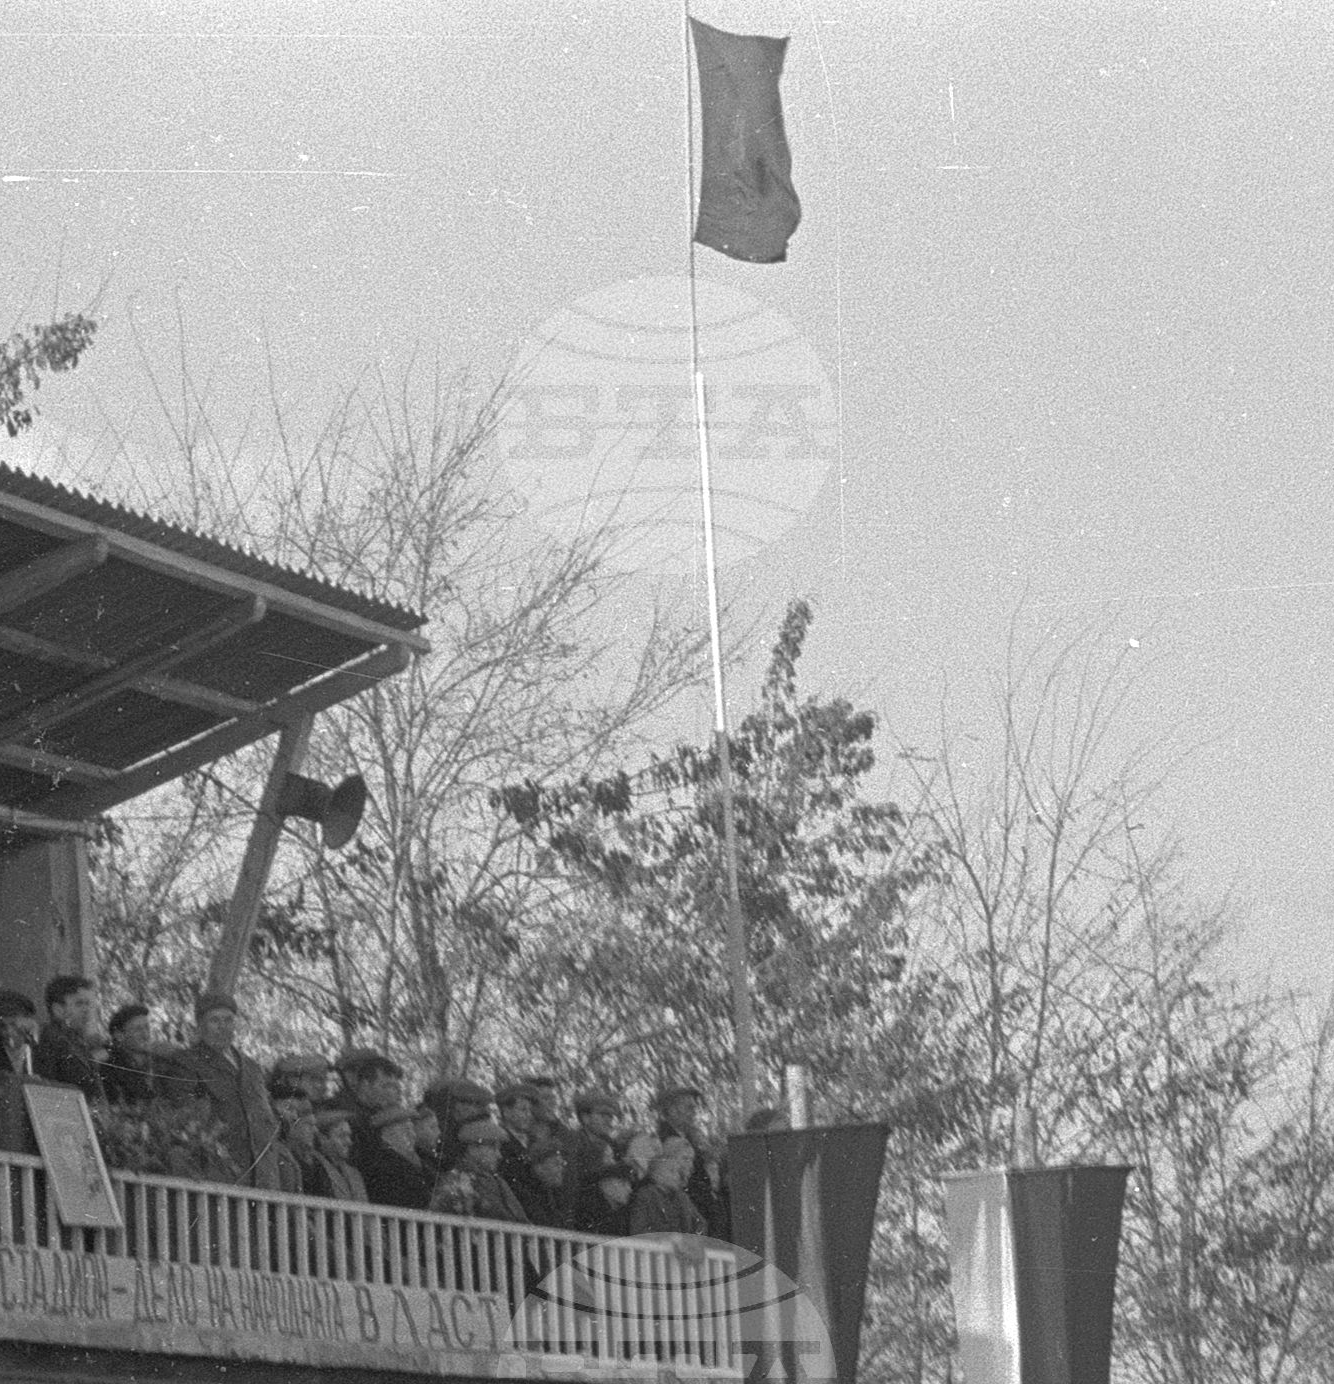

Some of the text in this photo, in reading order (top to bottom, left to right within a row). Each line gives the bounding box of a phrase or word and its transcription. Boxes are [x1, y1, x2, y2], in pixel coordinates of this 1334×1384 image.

[204, 1266, 239, 1331] НА
[238, 1270, 348, 1343] НАРОДНАТА
[353, 1284, 501, 1353] ВЛАСТ
